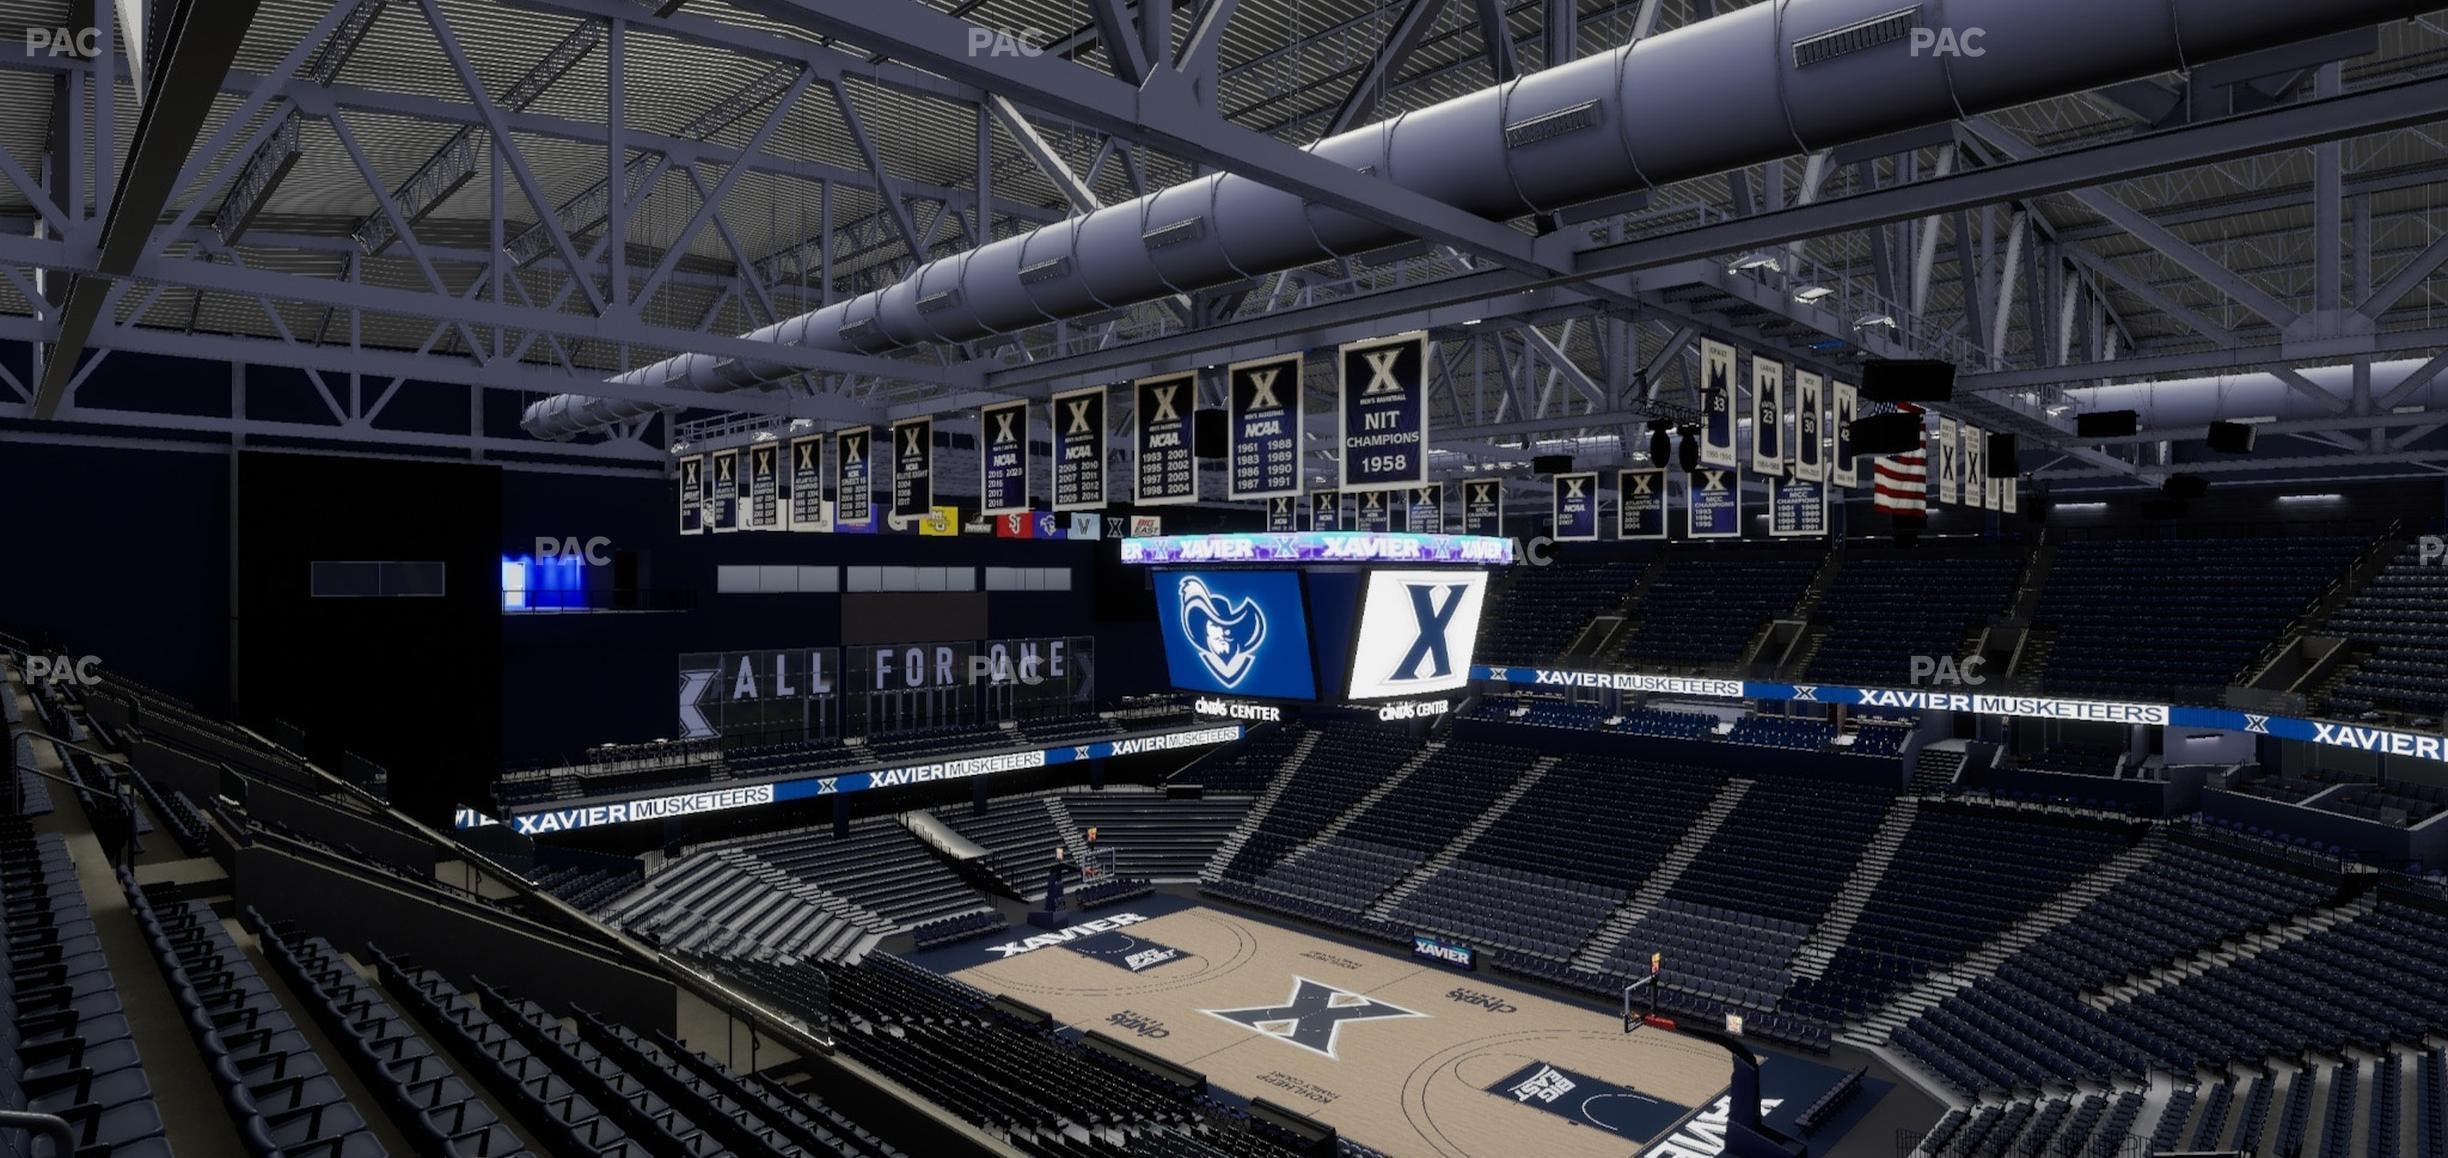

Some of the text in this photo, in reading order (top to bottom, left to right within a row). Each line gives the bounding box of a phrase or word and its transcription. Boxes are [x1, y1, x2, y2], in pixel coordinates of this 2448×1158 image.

[1362, 348, 1405, 396] X
[1247, 367, 1283, 412] X
[1151, 384, 1180, 424] X
[1067, 399, 1092, 435] X
[1365, 411, 1400, 430] NIT
[1763, 409, 1774, 424] 23
[1804, 419, 1815, 434] 30
[995, 413, 1017, 444] X
[1244, 420, 1281, 438] NCAA
[1841, 429, 1851, 442] 42
[904, 427, 921, 457] X
[1149, 432, 1180, 448] NCAA
[1237, 439, 1292, 453] 1961 1988
[1346, 431, 1420, 448] CHAMPIONS
[800, 444, 813, 470] X
[847, 436, 861, 464] X
[1142, 449, 1189, 462] 1993 2001
[1237, 451, 1292, 465] 1983 1989
[758, 452, 771, 475] X
[1142, 460, 1189, 474] 1995 2002
[1237, 463, 1292, 477] 1986 1990
[1362, 455, 1407, 473] 1958
[1142, 471, 1189, 485] 1997 2003
[1237, 476, 1292, 490] 1987 1991
[1632, 474, 1652, 494] X
[1702, 470, 1728, 491] X
[1142, 483, 1189, 496] 1998 2004
[1474, 484, 1492, 503] X
[1565, 479, 1586, 498] X
[1180, 539, 1253, 559] XAVIER
[1322, 537, 1421, 558] XAVIER
[733, 641, 1063, 699] ALL FOR ONE
[1535, 670, 1740, 695] XAVIER MUSKETEERS
[1230, 704, 1279, 721] CENTER
[1416, 700, 1449, 717] CENTER
[1858, 688, 2163, 723] XAVIER MUSKETEERS
[1111, 727, 1238, 756] XAVIER MUSKETEERS
[2313, 722, 2441, 762] XAVIER
[869, 751, 1042, 788] XAVIER MUSKETEERS
[514, 787, 770, 835] XAVIER MUSKETEERS
[985, 912, 1148, 958] XAVIER
[1415, 940, 1469, 965] XAVIER
